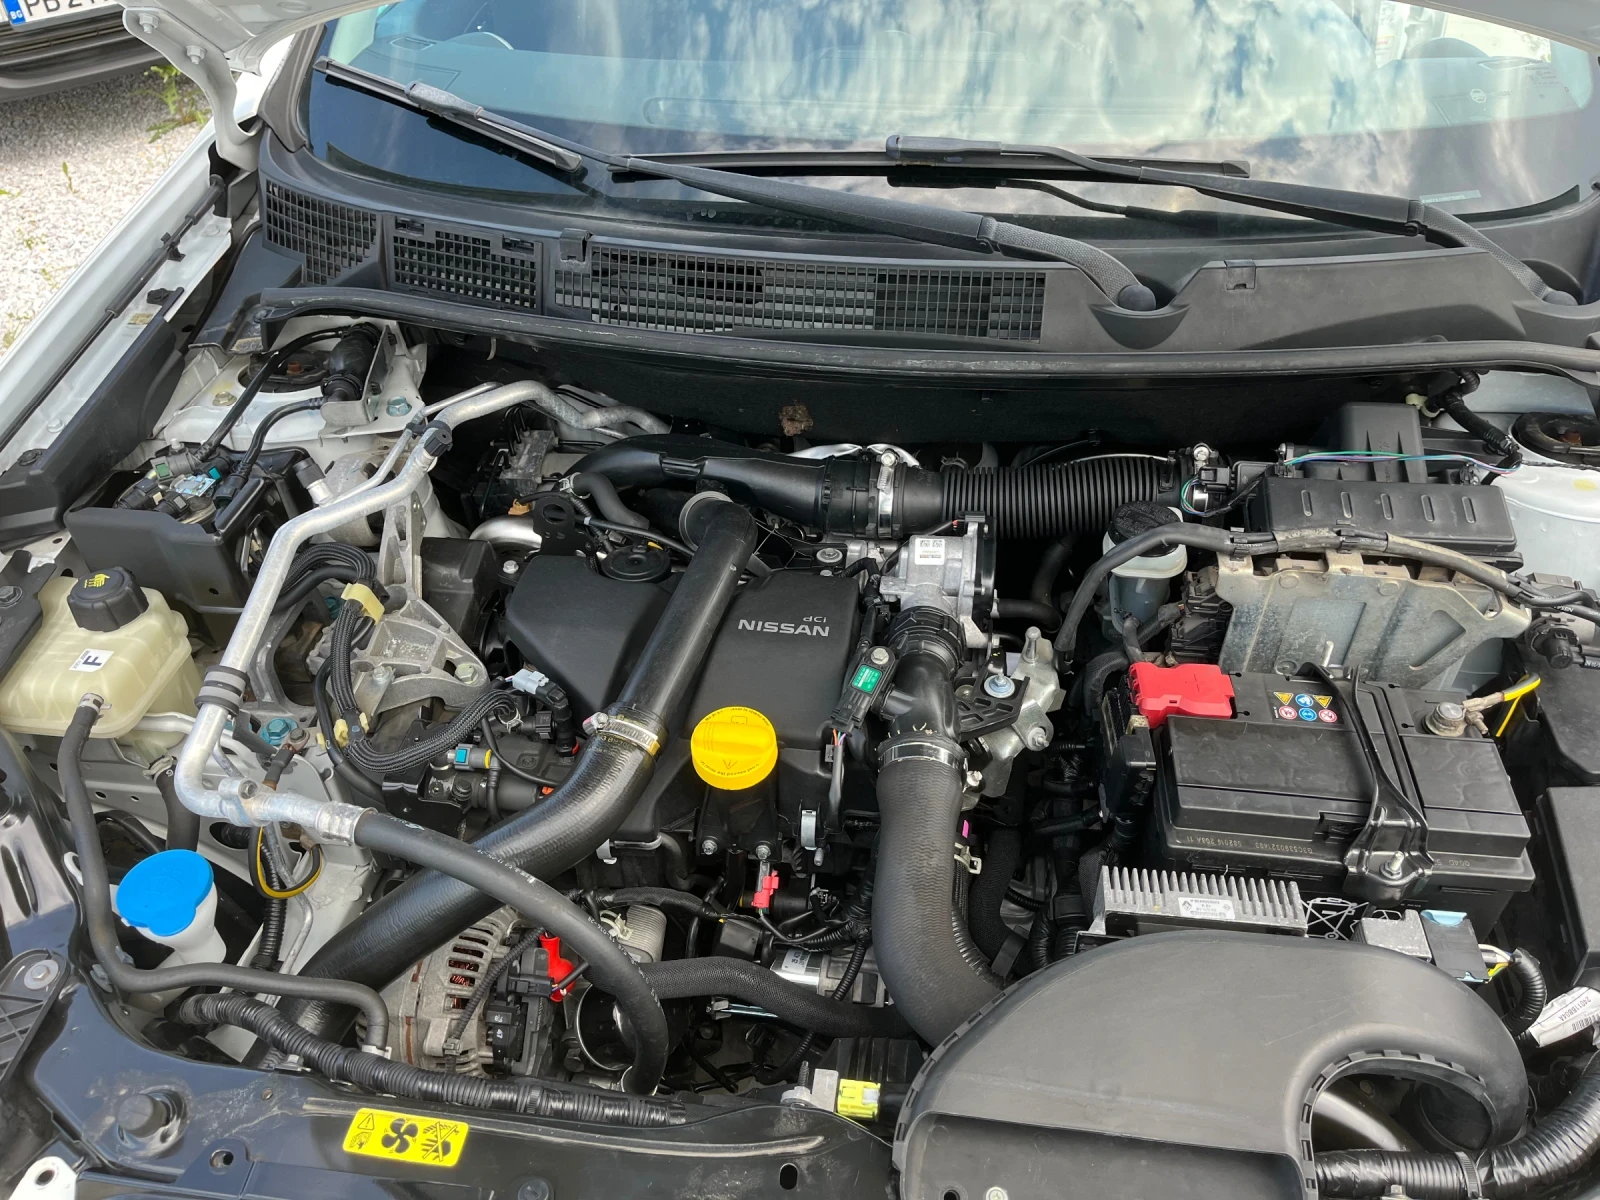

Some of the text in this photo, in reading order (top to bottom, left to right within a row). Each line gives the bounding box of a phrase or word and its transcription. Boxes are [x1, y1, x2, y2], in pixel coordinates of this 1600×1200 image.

[10, 10, 23, 19] BG
[738, 619, 830, 637] NISSAN
[82, 655, 102, 666] F
